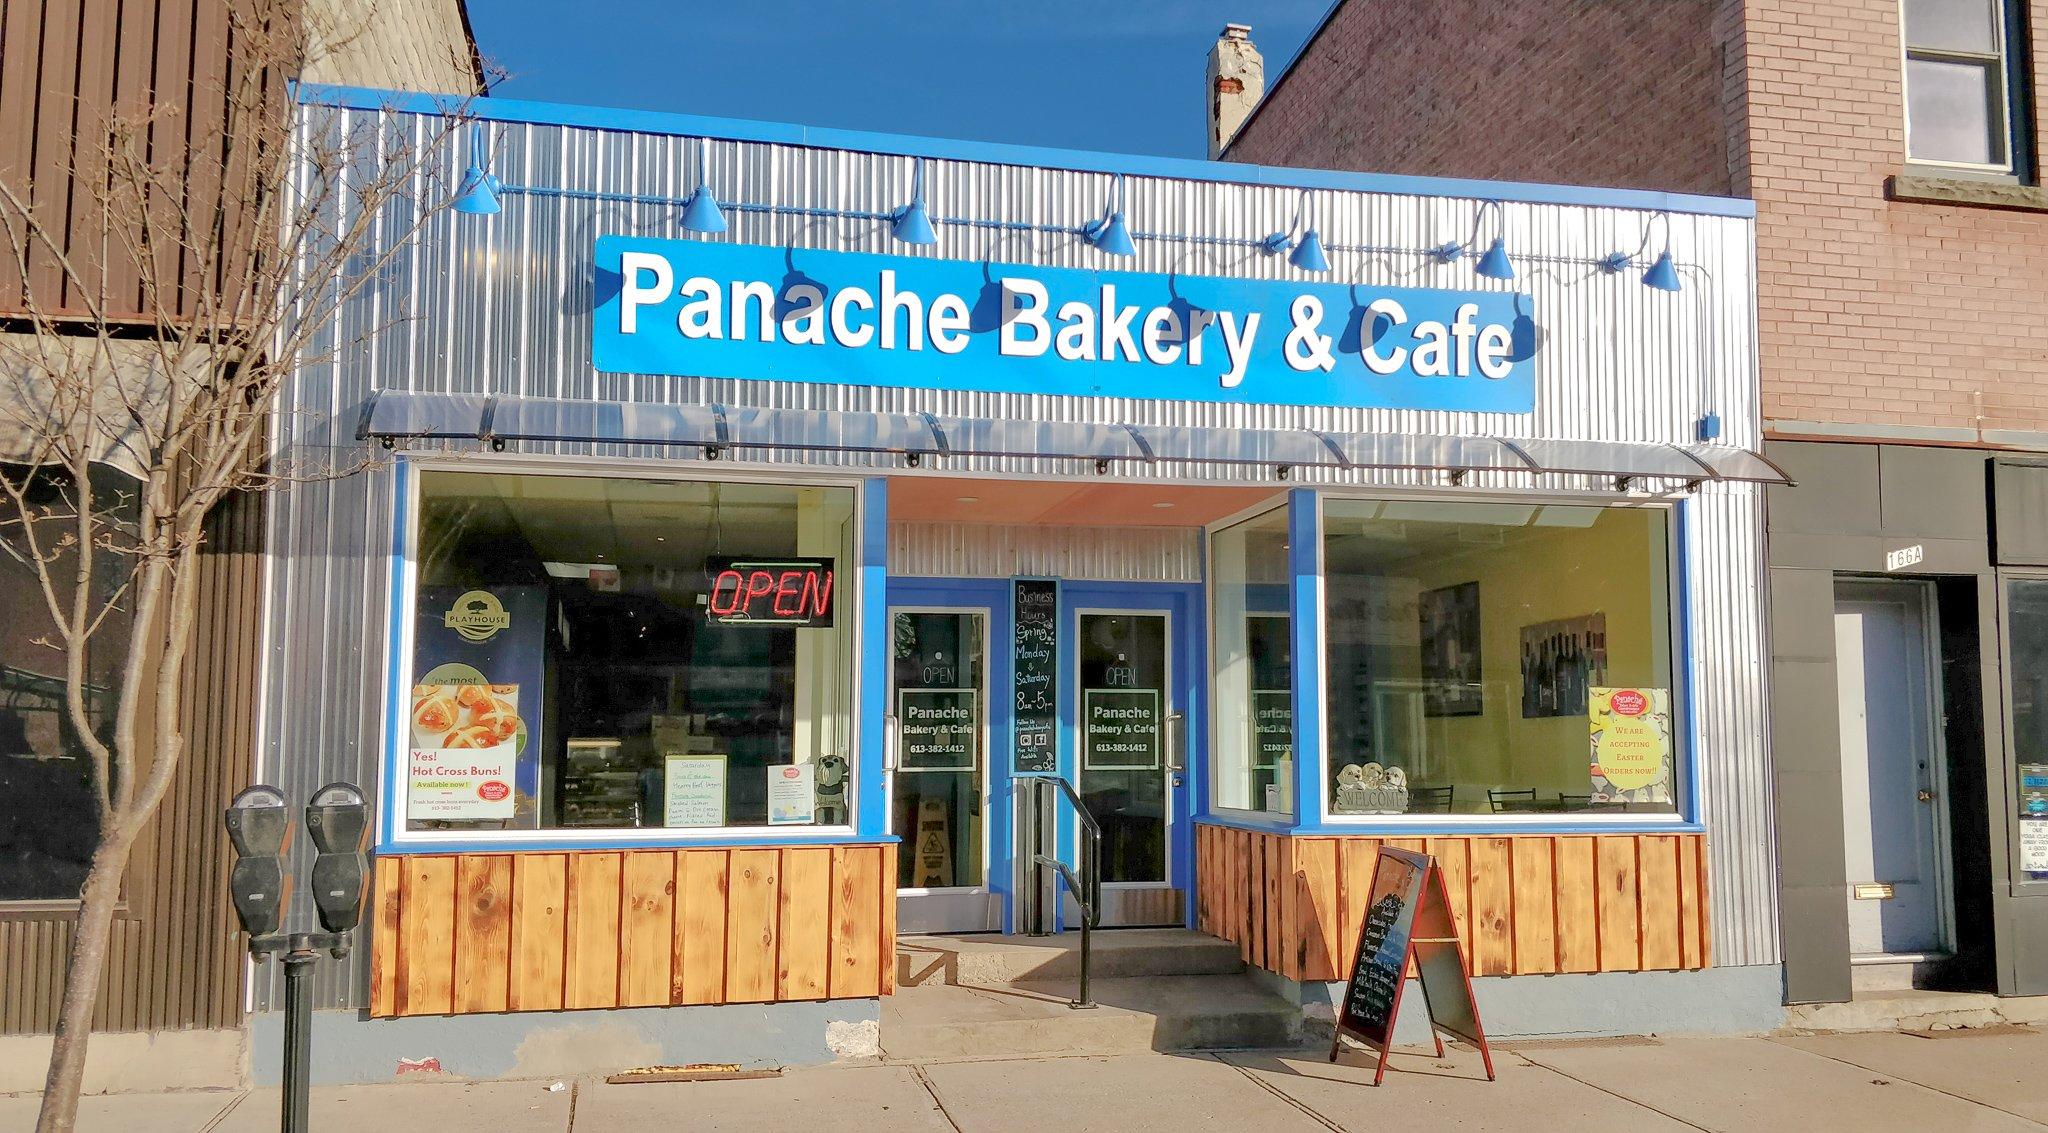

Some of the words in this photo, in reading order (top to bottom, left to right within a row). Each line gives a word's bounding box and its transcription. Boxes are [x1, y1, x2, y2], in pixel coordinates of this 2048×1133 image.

[620, 251, 971, 355] Panache
[1000, 277, 1260, 388] Bakery
[1283, 294, 1336, 373] &
[1359, 298, 1514, 379] Cafe
[1888, 546, 1922, 569] 166A
[710, 570, 833, 615] OPEN
[1018, 585, 1054, 603] Business
[449, 615, 506, 624] PLAYHOUSE
[1020, 606, 1046, 620] Hours
[1016, 625, 1048, 640] Spring
[1015, 643, 1050, 663] Monday
[450, 677, 477, 685] most
[923, 666, 955, 684] OPEN
[1015, 671, 1051, 689] Saturday
[1106, 667, 1136, 686] OPEN
[908, 706, 969, 719] Panache
[1094, 706, 1150, 719] Panache
[903, 725, 939, 738] Bakery
[941, 725, 949, 734] &
[950, 725, 973, 734] Cafe
[1089, 724, 1122, 737] Bakery
[1125, 724, 1132, 733] &
[1134, 724, 1155, 734] Cafe
[910, 744, 965, 753] 613-382-1412
[1096, 743, 1148, 752] 613-382-1412
[413, 752, 437, 761] Yes!
[412, 766, 433, 776] Hot
[436, 766, 468, 776] Cross
[471, 765, 502, 776] Buns!
[1344, 791, 1404, 807] WELCOME
